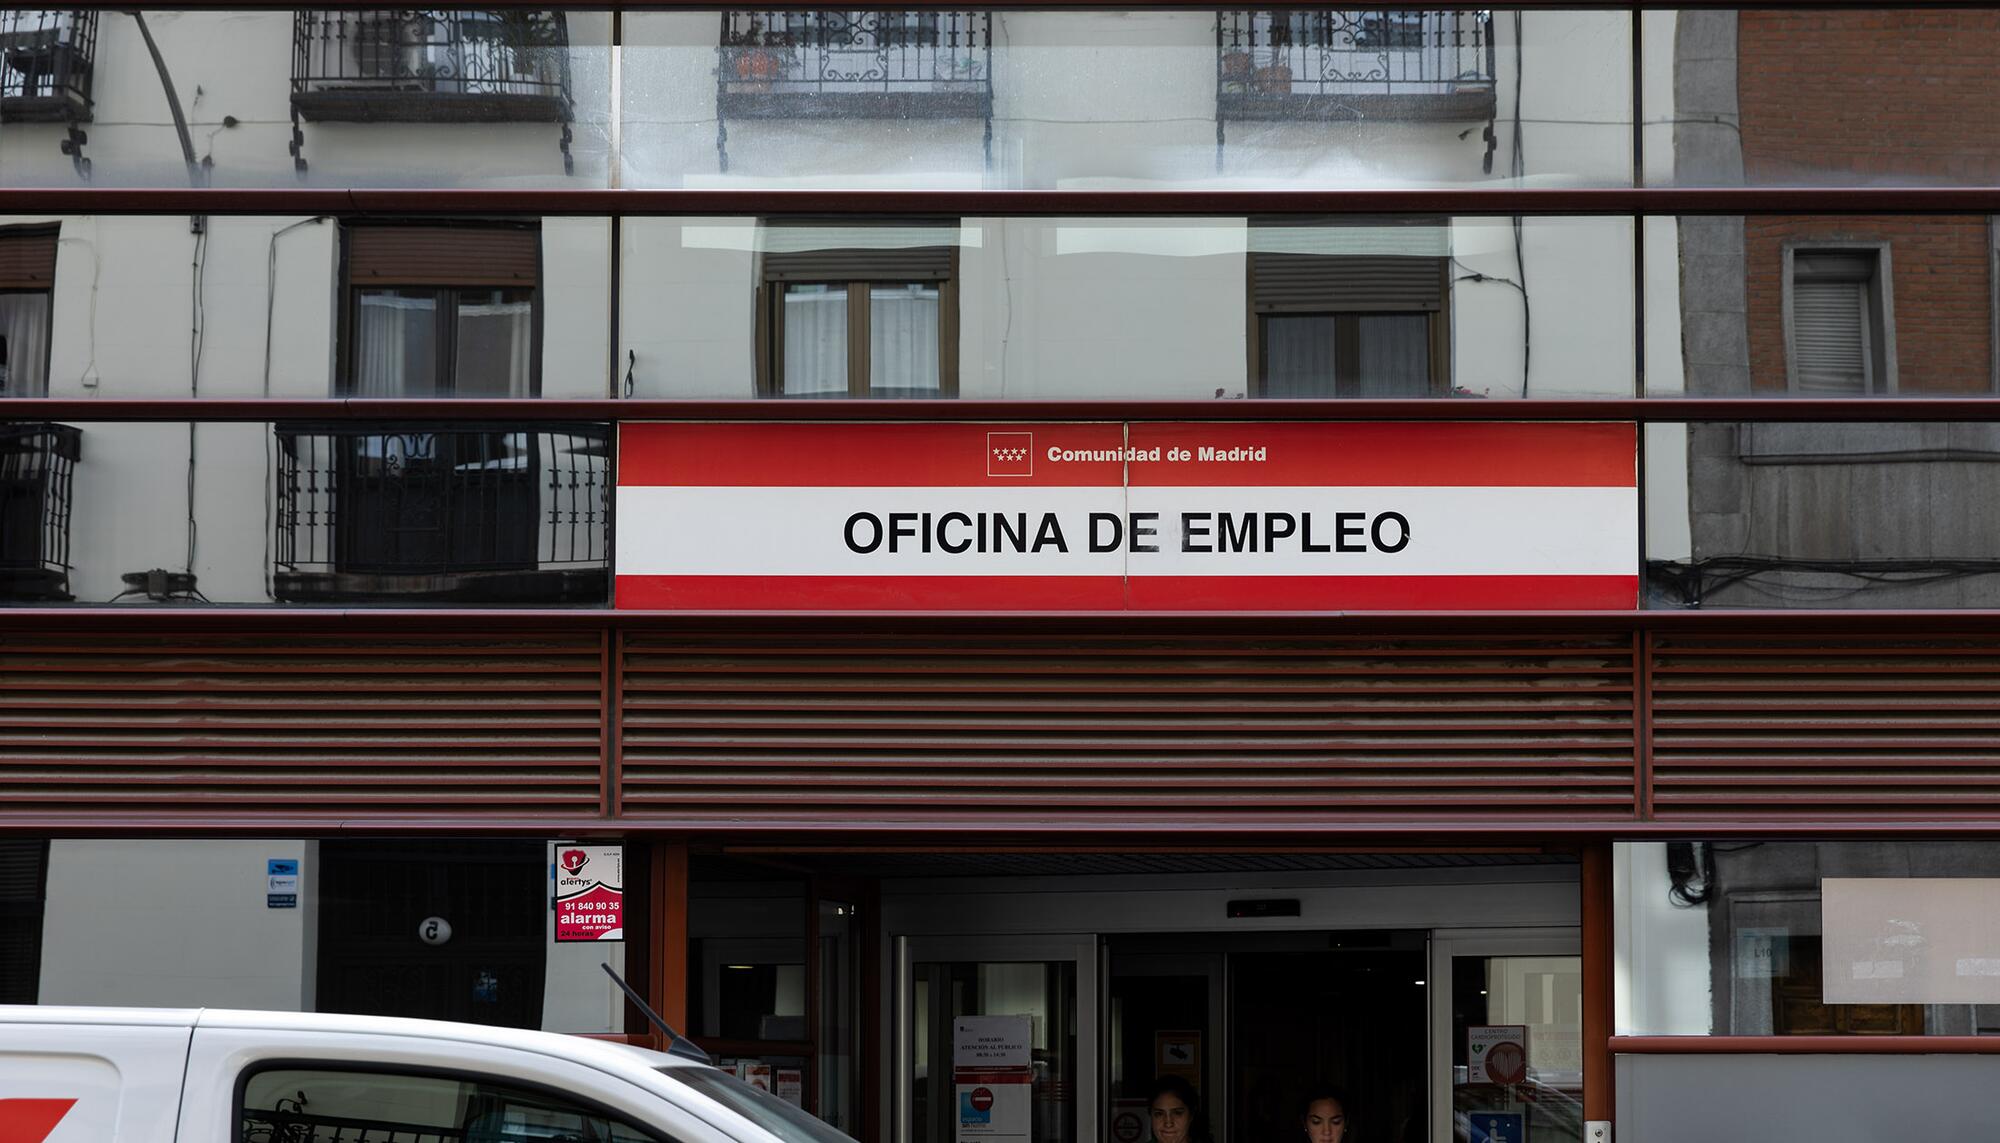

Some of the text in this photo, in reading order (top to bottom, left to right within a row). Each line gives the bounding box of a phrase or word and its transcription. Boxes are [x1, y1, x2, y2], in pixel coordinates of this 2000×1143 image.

[1047, 446, 1267, 462] Comunidad de Madrid
[843, 511, 1412, 554] OFICINA DE EMPLEO
[560, 877, 591, 887] alertys
[565, 902, 620, 911] 91 840 90 35
[560, 912, 616, 924] alarma
